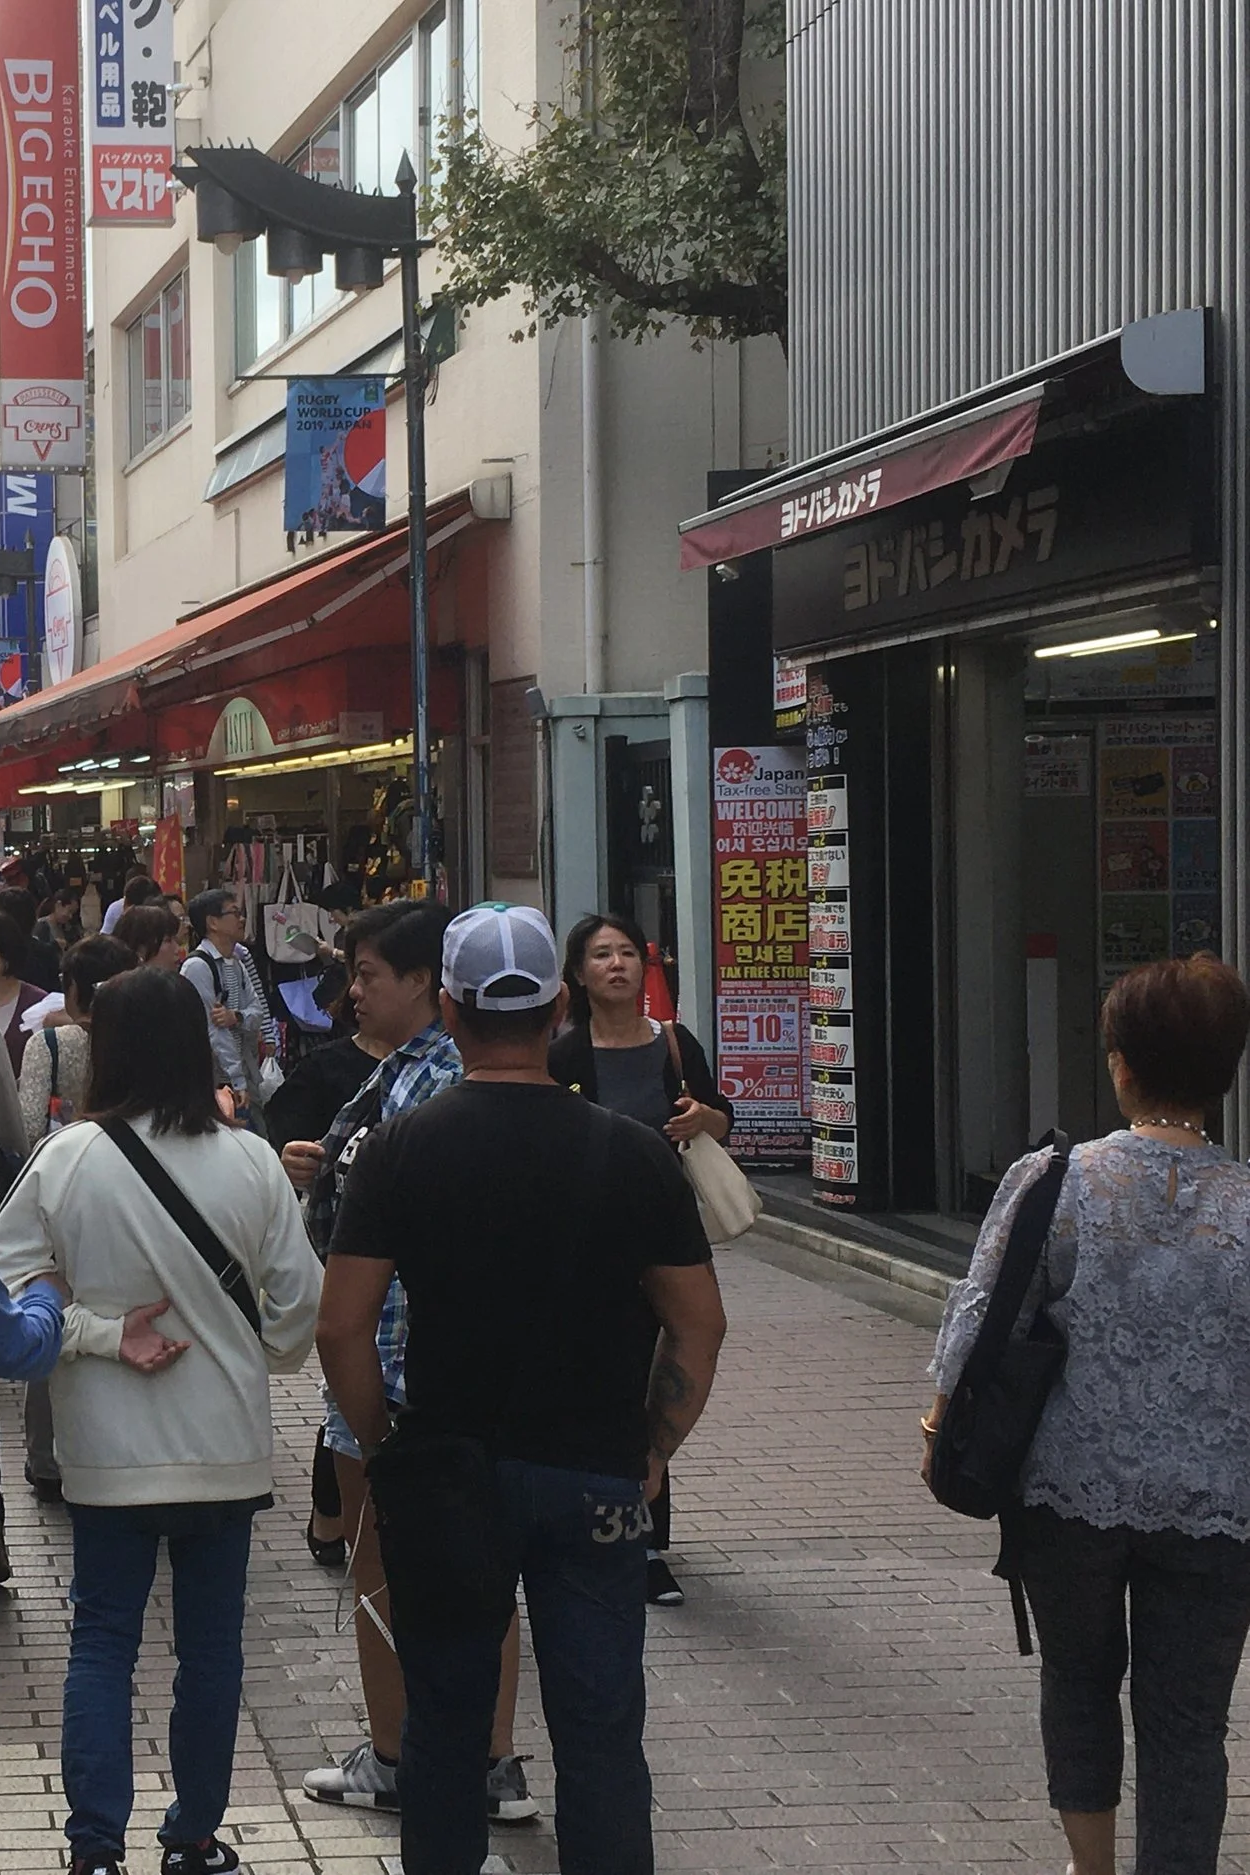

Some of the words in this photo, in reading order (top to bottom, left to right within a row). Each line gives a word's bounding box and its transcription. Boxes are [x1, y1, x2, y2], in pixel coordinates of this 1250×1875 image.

[3, 58, 54, 162] BIG
[61, 84, 75, 158] Karaoke
[99, 152, 165, 165] バッグハウス
[100, 168, 169, 210] マスヤ
[10, 175, 58, 329] ECHO
[63, 167, 78, 302] Entertainment
[297, 394, 340, 405] RUGBY
[297, 407, 343, 418] WORLD
[346, 407, 372, 418] CUP
[296, 420, 326, 431] 2019,
[329, 419, 372, 431] JAPAN
[6, 474, 38, 517] M
[780, 468, 882, 538] ヨドバシカメラ
[843, 488, 1059, 611] ヨドバシカメラ
[717, 784, 771, 797] Tax-free
[716, 838, 745, 853] 어서
[751, 837, 809, 853] 오십시오
[732, 822, 794, 837] 欢迎光临
[720, 859, 807, 899] 免税
[721, 904, 807, 942] 商店
[720, 967, 741, 979] TAX
[744, 967, 770, 979] FREE
[773, 966, 809, 979] STORE
